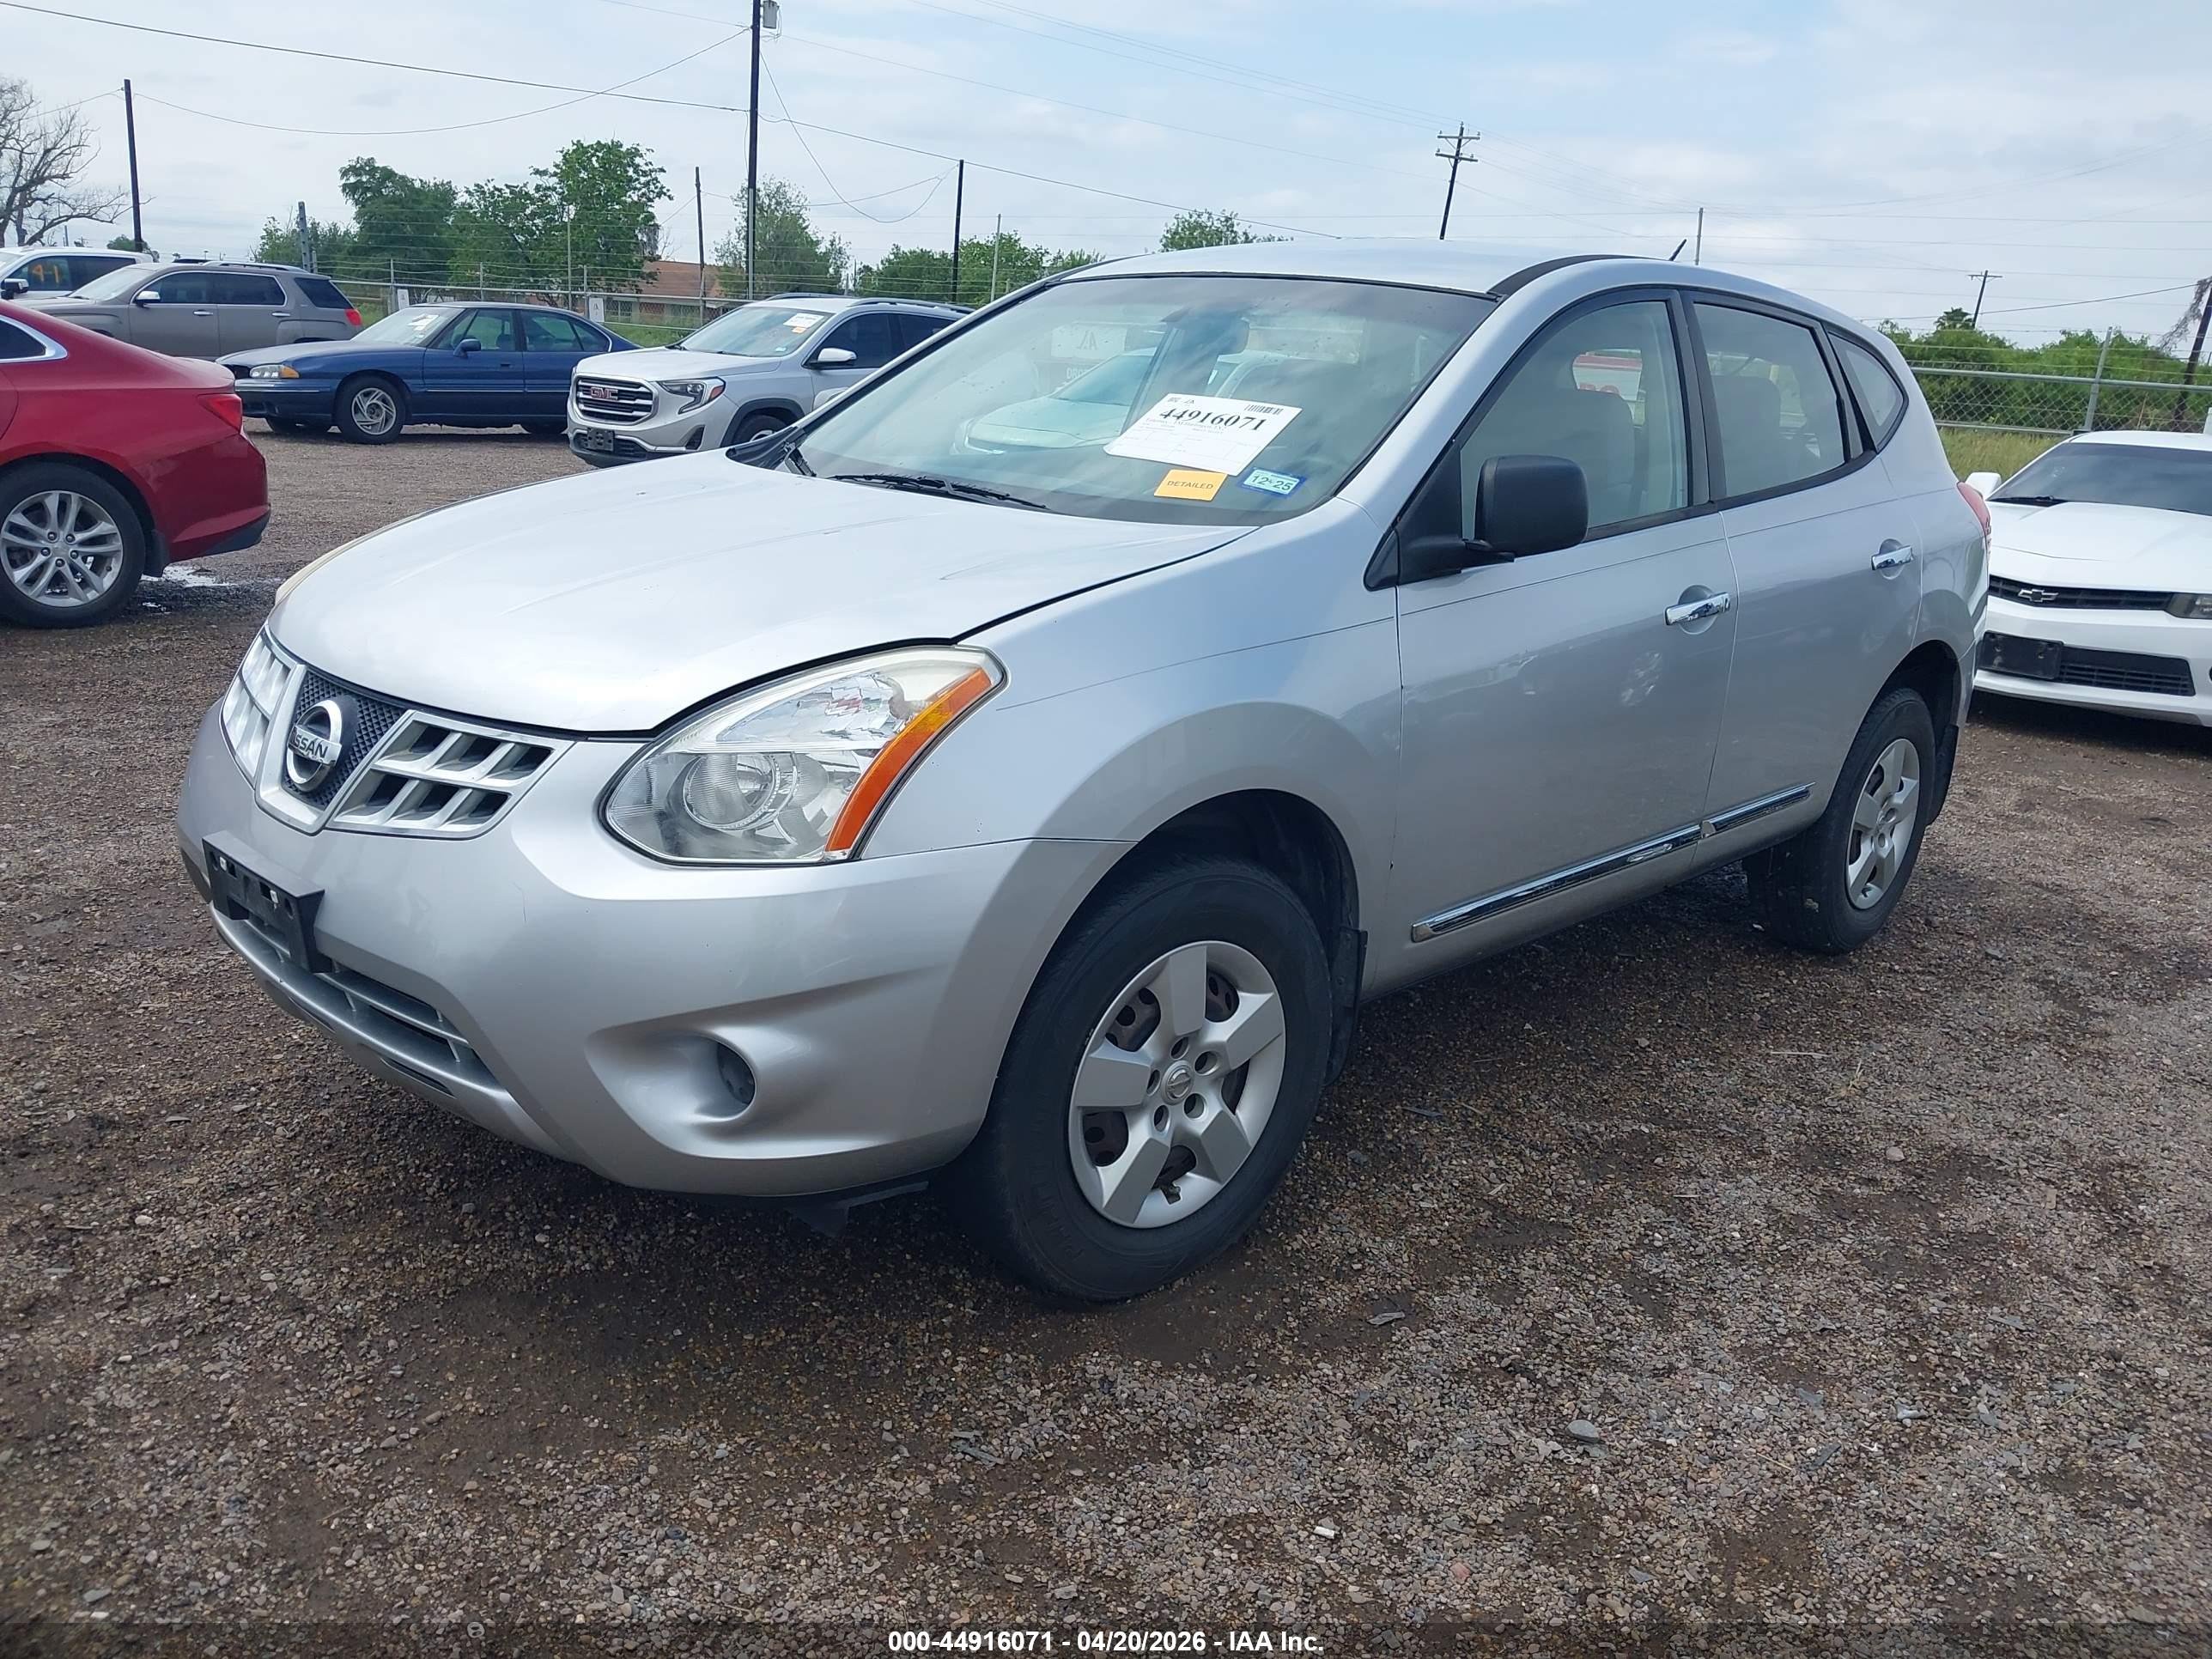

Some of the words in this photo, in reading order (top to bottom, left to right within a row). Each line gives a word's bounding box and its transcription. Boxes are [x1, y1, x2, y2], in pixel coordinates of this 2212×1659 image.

[591, 387, 618, 401] GMC
[1159, 408, 1267, 431] 44916071
[1167, 480, 1214, 490] DETAILED
